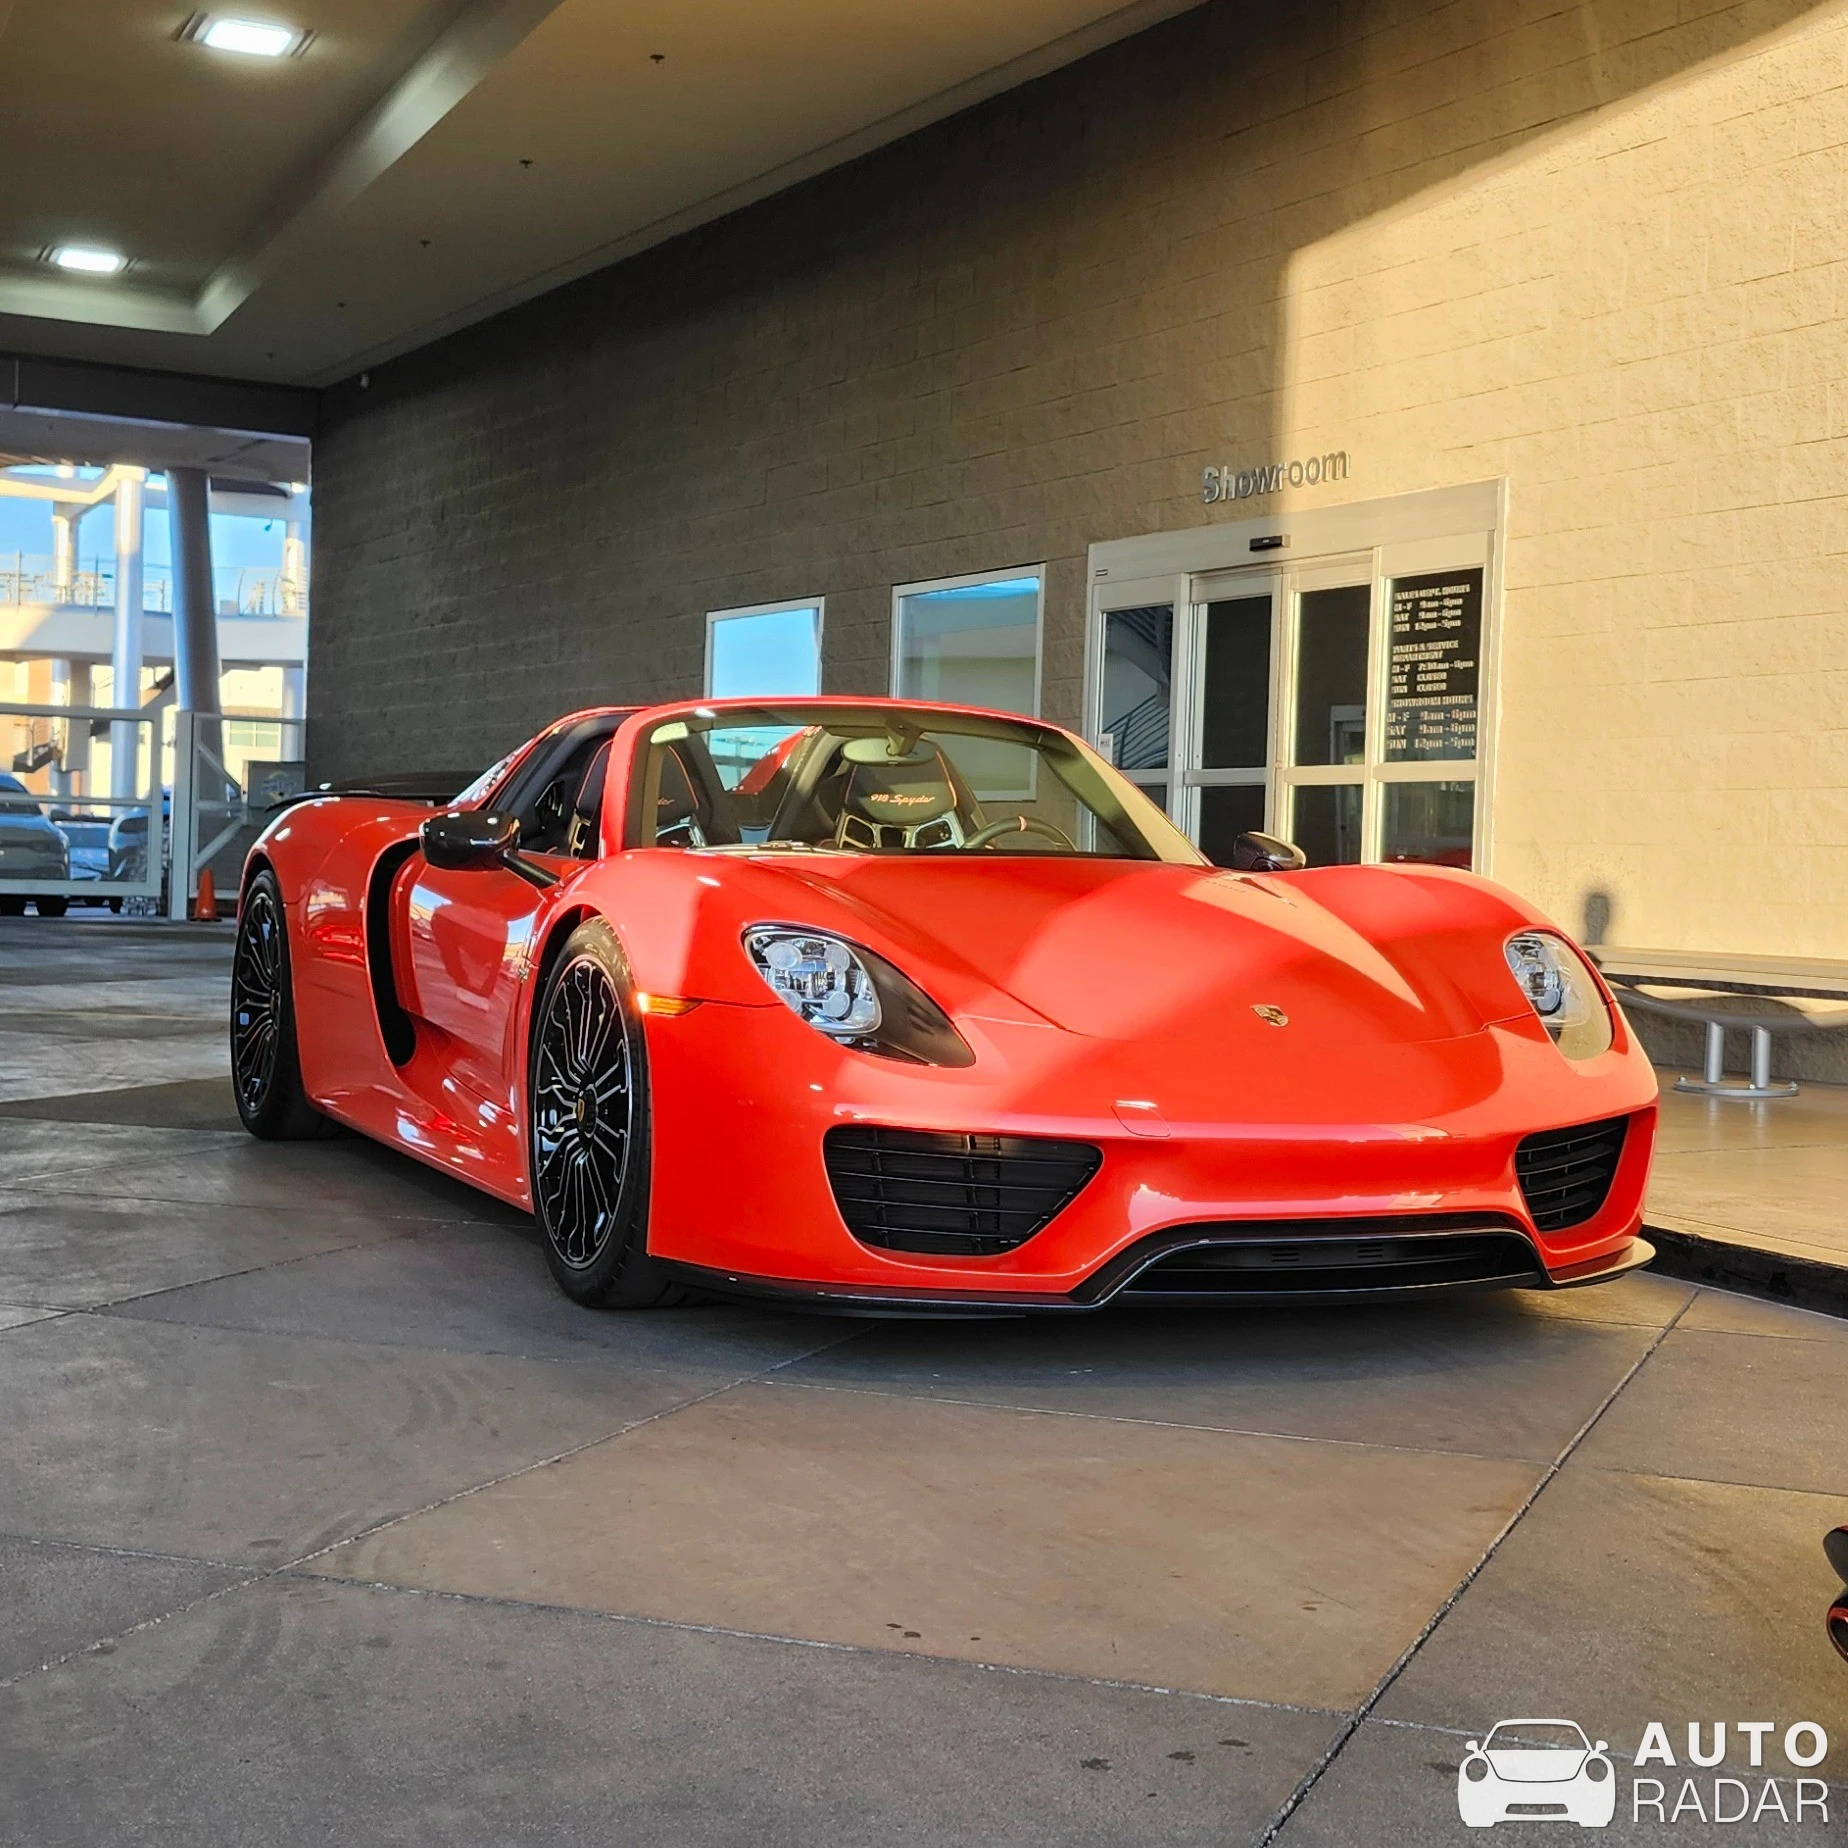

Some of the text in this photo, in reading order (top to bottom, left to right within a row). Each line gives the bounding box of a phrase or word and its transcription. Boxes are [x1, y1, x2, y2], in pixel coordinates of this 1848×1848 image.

[1202, 450, 1350, 503] Showroom
[1442, 584, 1470, 595] HOURS
[1394, 613, 1409, 621] SAT
[1394, 623, 1410, 632] SUN
[1393, 644, 1418, 653] PARTS
[1426, 640, 1458, 650] SERVICE
[1393, 651, 1443, 662] DEPARTMENT
[1417, 672, 1446, 681] CLOSED
[1417, 683, 1446, 691] CLOSED
[1392, 695, 1473, 707] SHOWROOM HOURS
[1388, 725, 1406, 735] SAT
[871, 794, 935, 806] 918 Spyder
